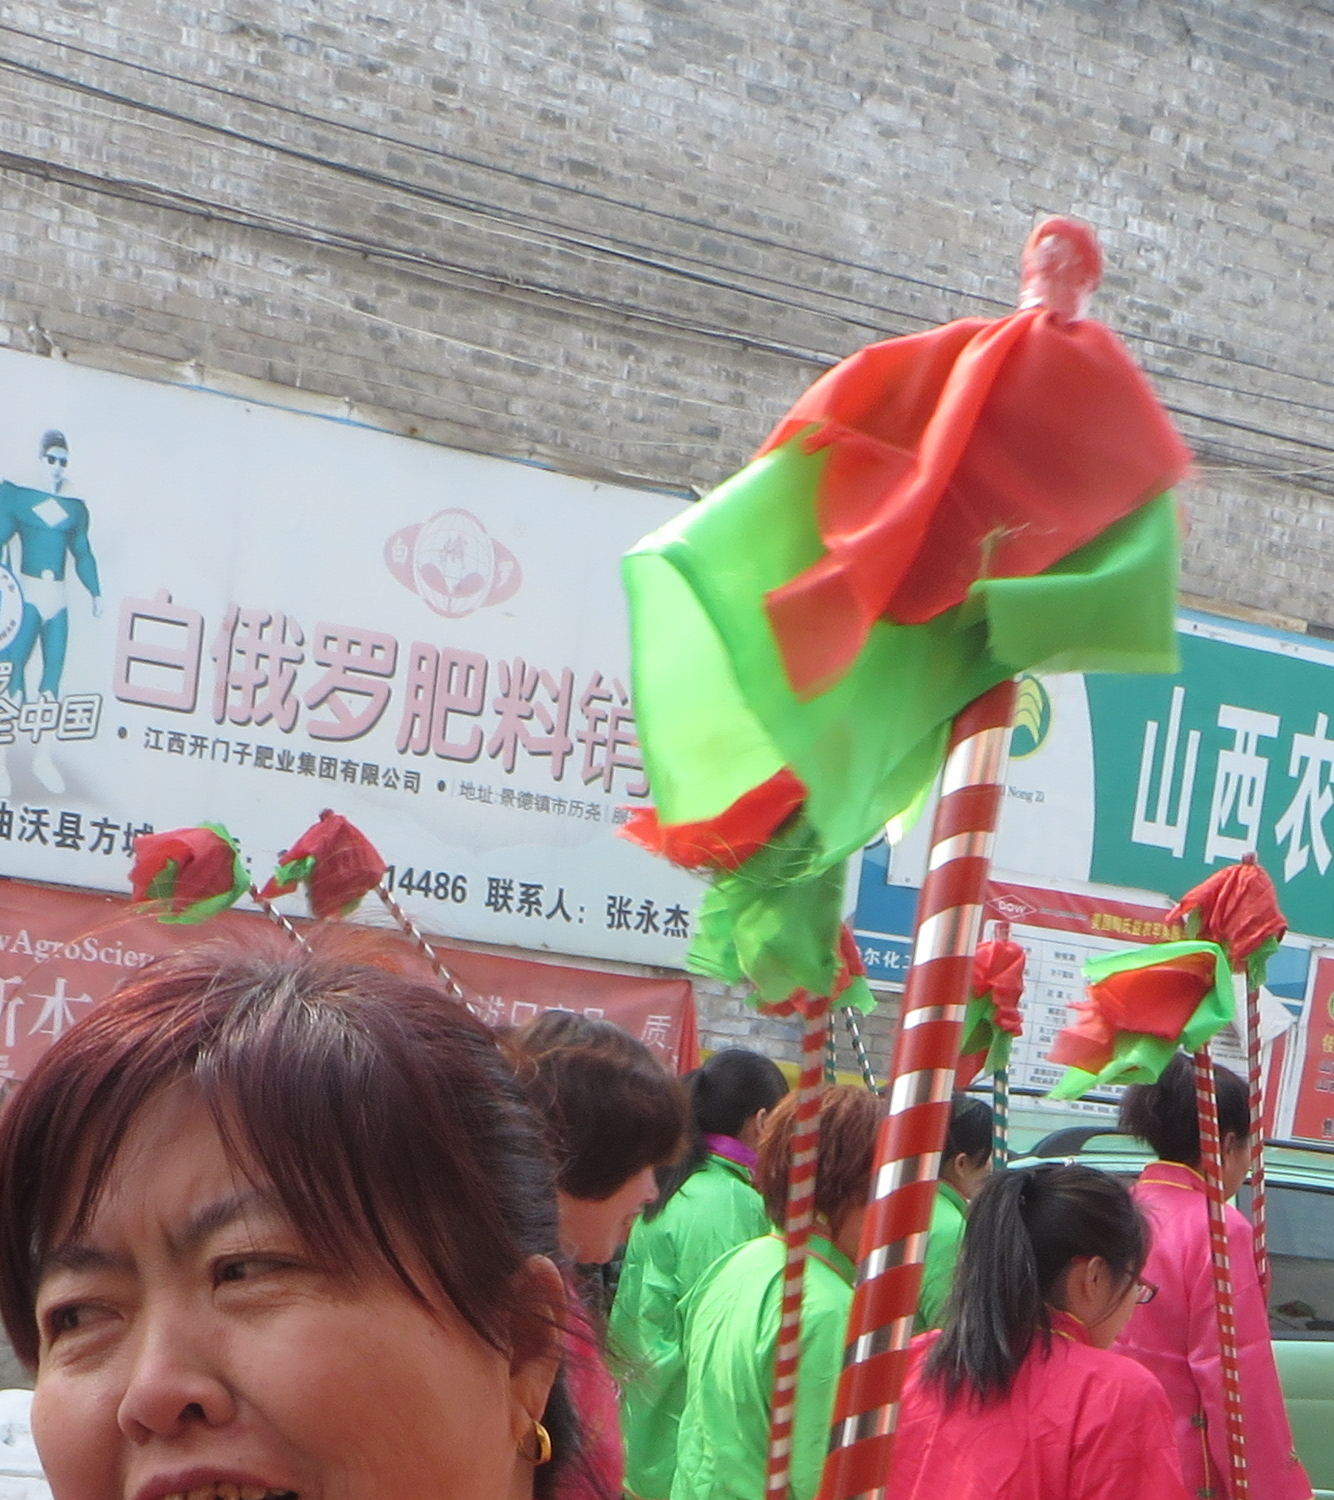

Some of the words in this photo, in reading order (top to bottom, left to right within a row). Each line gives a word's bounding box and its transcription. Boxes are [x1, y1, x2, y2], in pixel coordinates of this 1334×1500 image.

[144, 726, 423, 794] 江西开门子肥业集团有限公司
[484, 875, 586, 925] 联系人:
[605, 894, 691, 940] 张永杰
